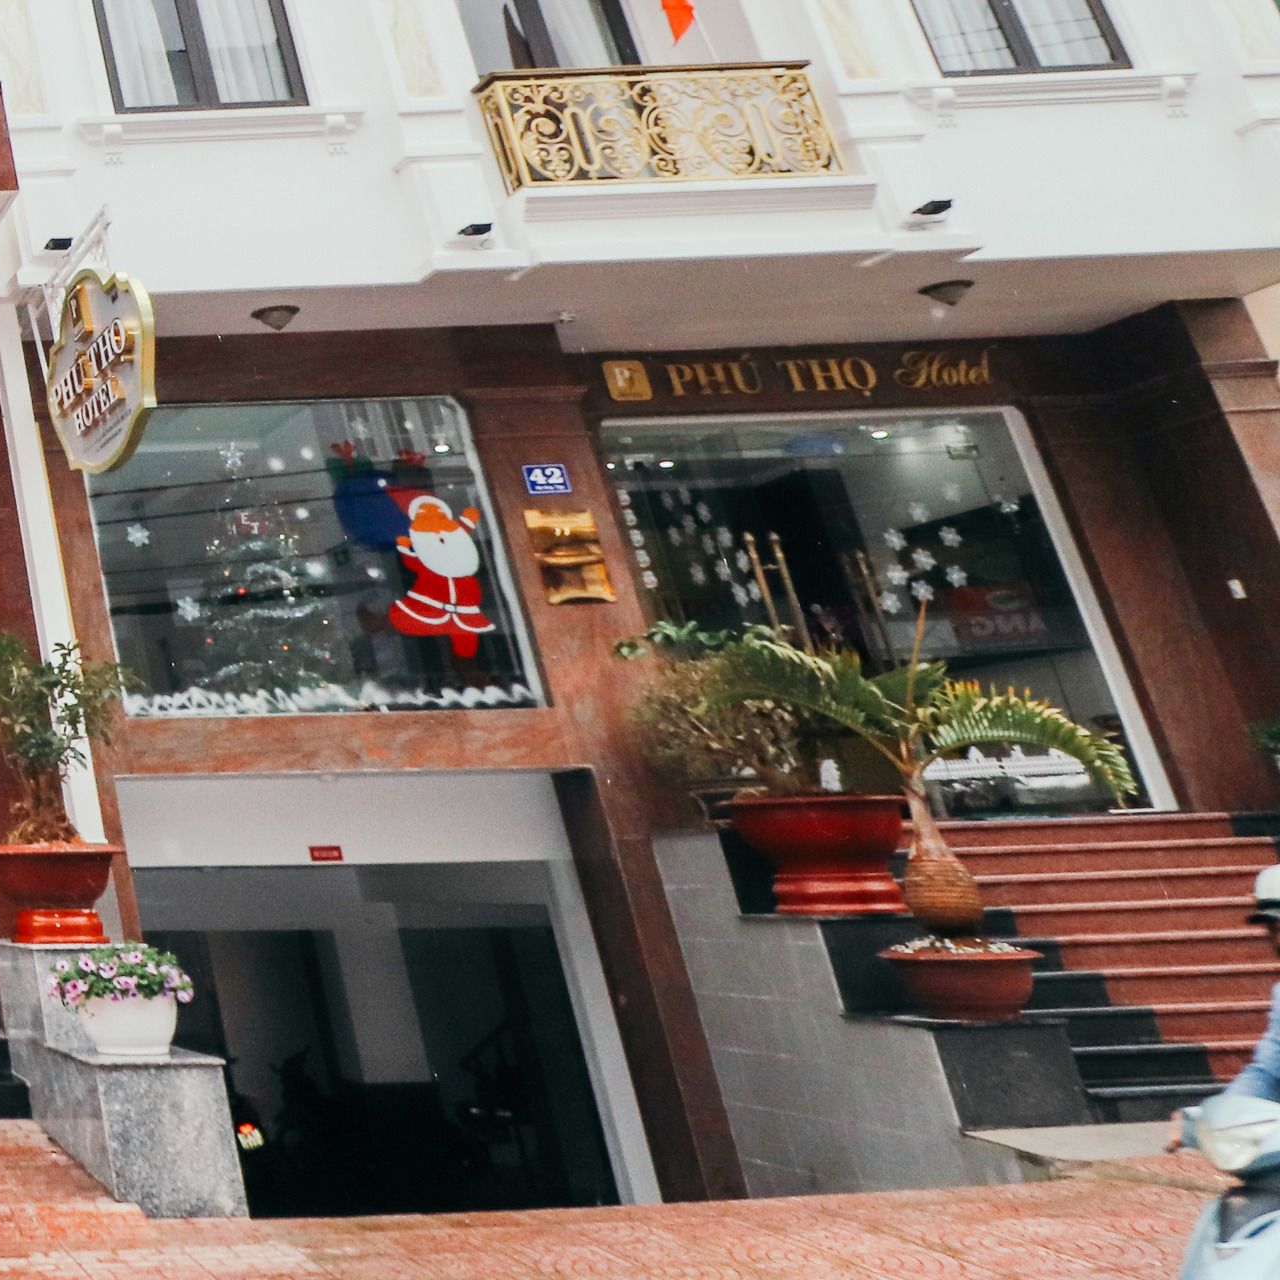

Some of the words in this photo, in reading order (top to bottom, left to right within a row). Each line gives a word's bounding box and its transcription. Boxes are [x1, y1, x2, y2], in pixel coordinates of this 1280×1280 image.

[664, 353, 763, 397] PHÚ
[777, 356, 877, 397] THỌ
[893, 346, 996, 392] Hotel
[73, 376, 121, 436] HOTEL
[529, 467, 564, 485] 42
